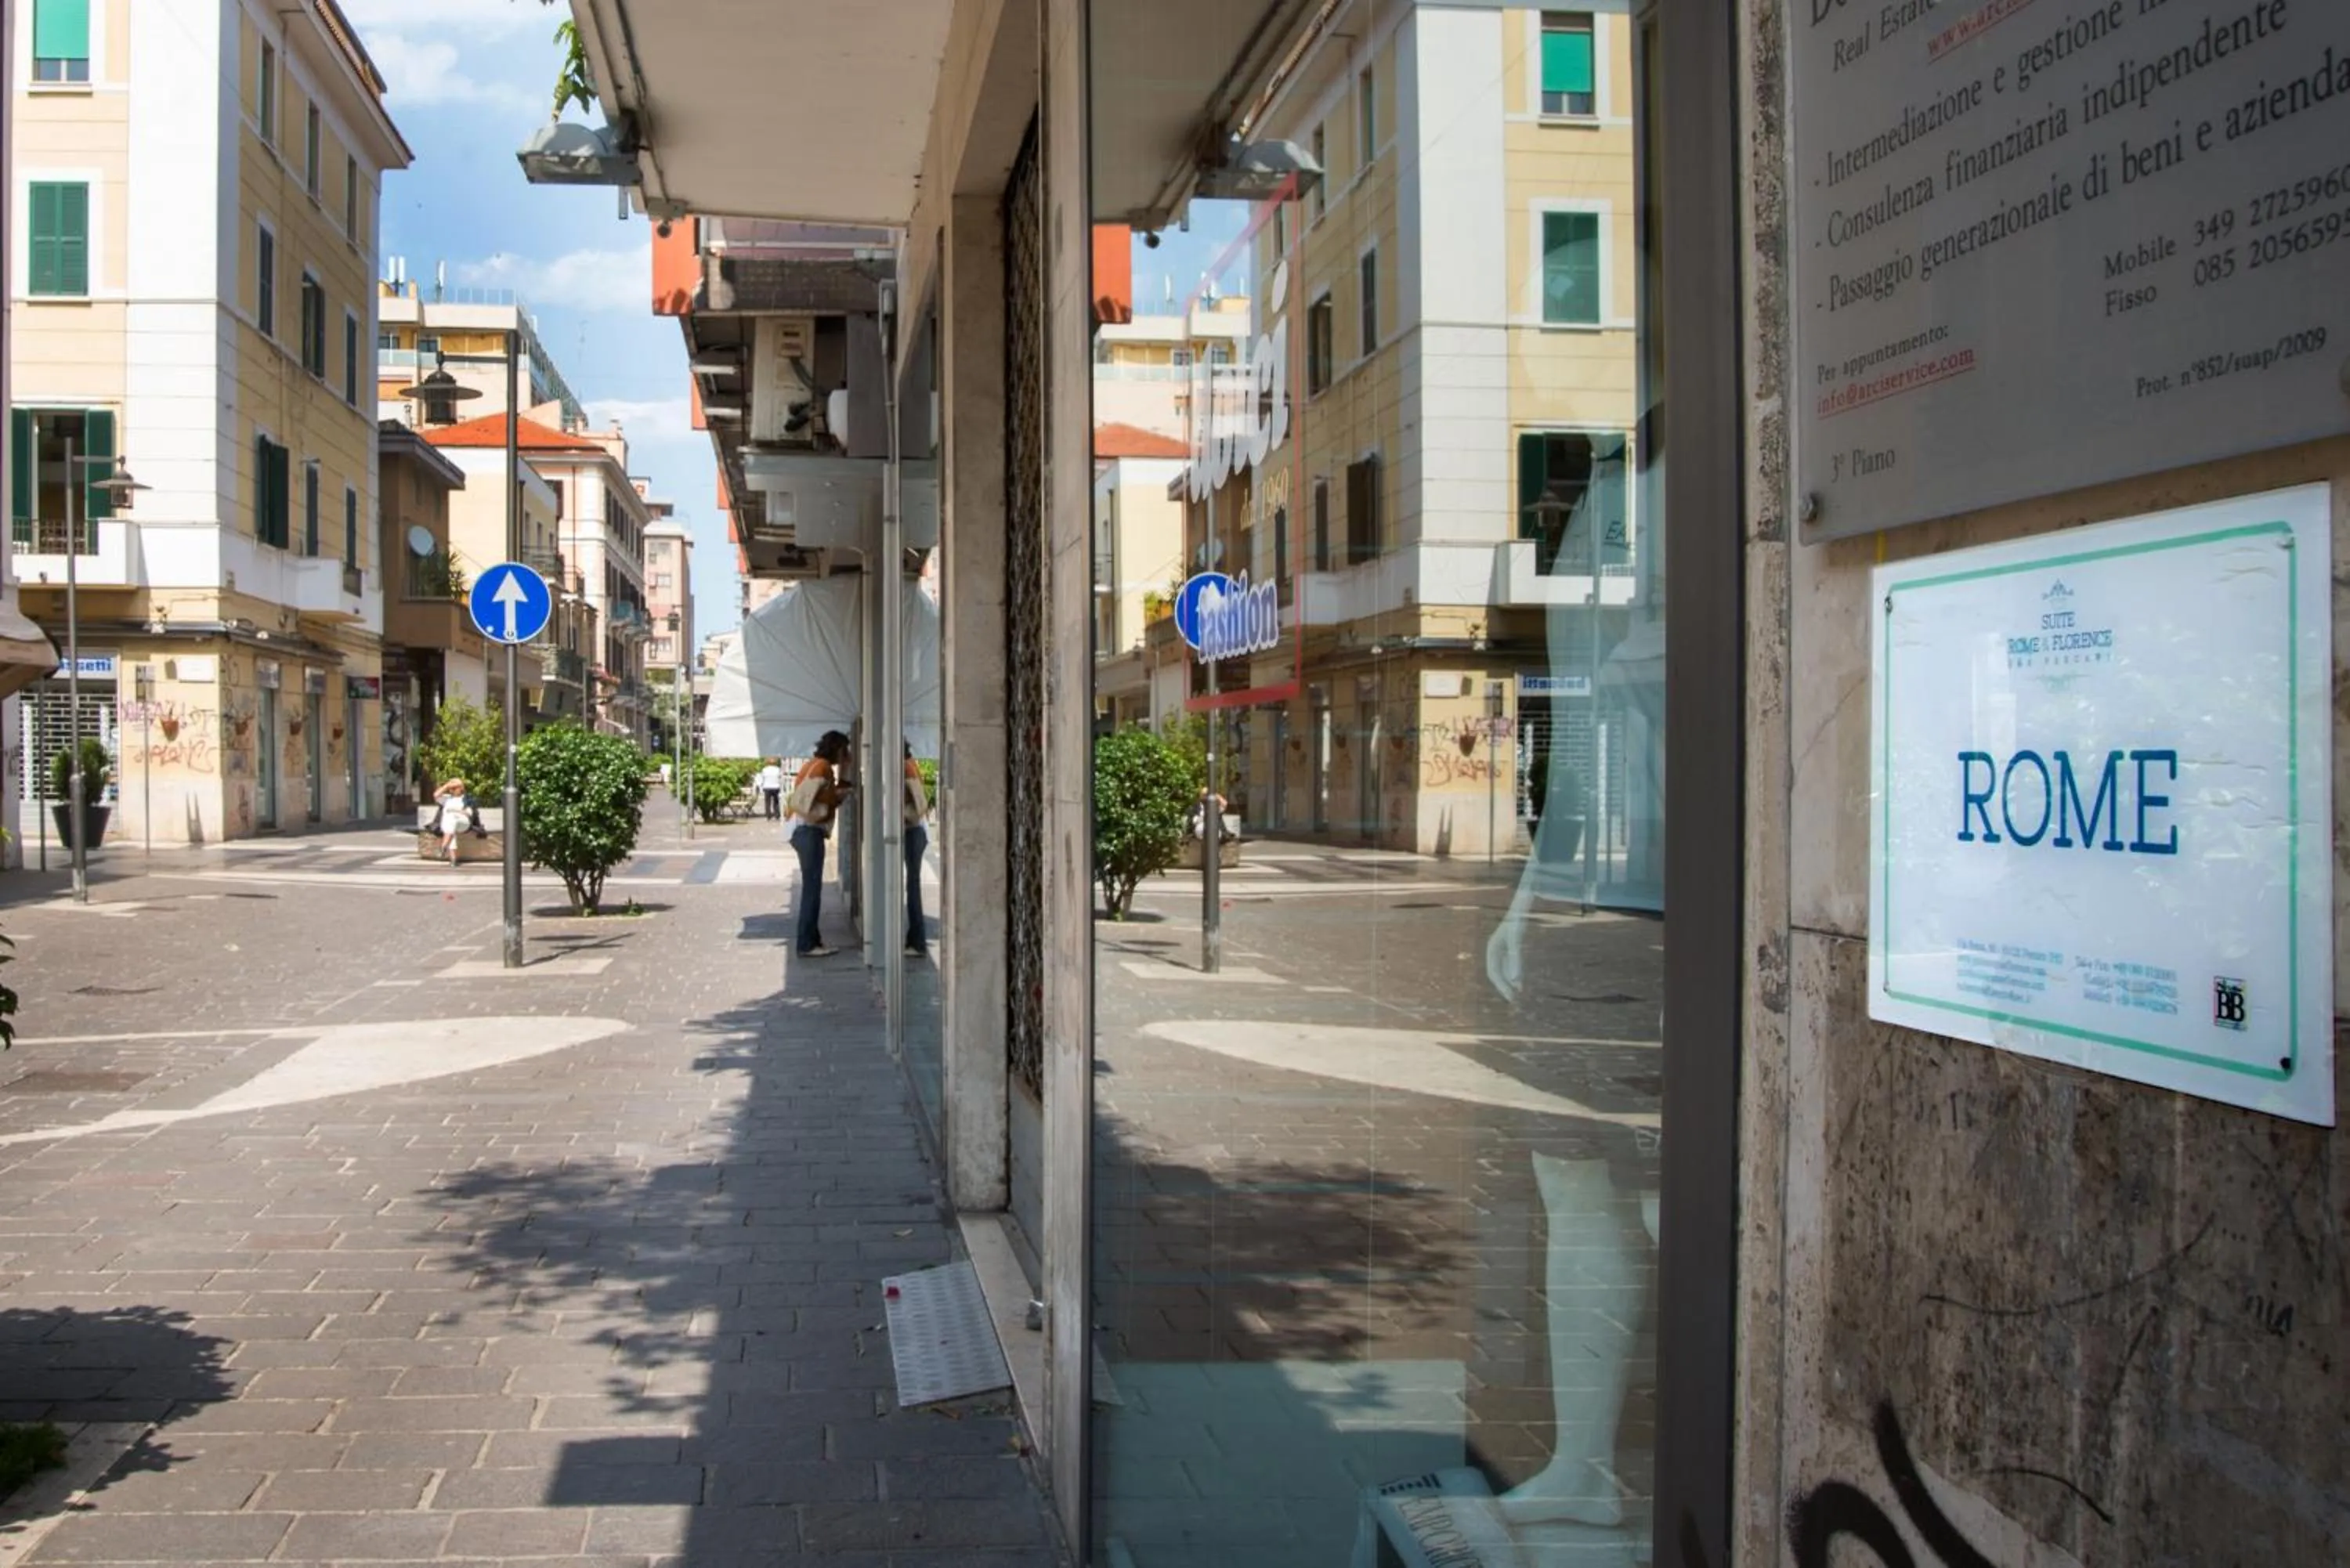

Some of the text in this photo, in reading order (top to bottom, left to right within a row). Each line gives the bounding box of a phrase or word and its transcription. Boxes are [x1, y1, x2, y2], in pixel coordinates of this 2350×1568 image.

[1832, 20, 1871, 73] Real
[1827, 1, 2122, 187] Intermediazione e gestione
[1828, 0, 2287, 248] Consulenza finanziaria indipendente
[1829, 249, 1914, 313] Passaggio
[2083, 153, 2110, 201] di
[2120, 118, 2186, 185] beni
[2196, 120, 2213, 152] e
[2104, 236, 2177, 280] Mobile
[2193, 208, 2234, 248] 349
[2106, 285, 2158, 317] Fisso
[2193, 247, 2236, 287] 085
[1817, 325, 1949, 385] Per appuntamento:
[1852, 448, 1896, 478] Piano
[1198, 568, 1279, 665] fashion
[2007, 637, 2040, 654] ROME
[2052, 630, 2113, 651] FLORENCE
[2041, 611, 2076, 630] SUITE
[1957, 750, 2178, 855] ROME
